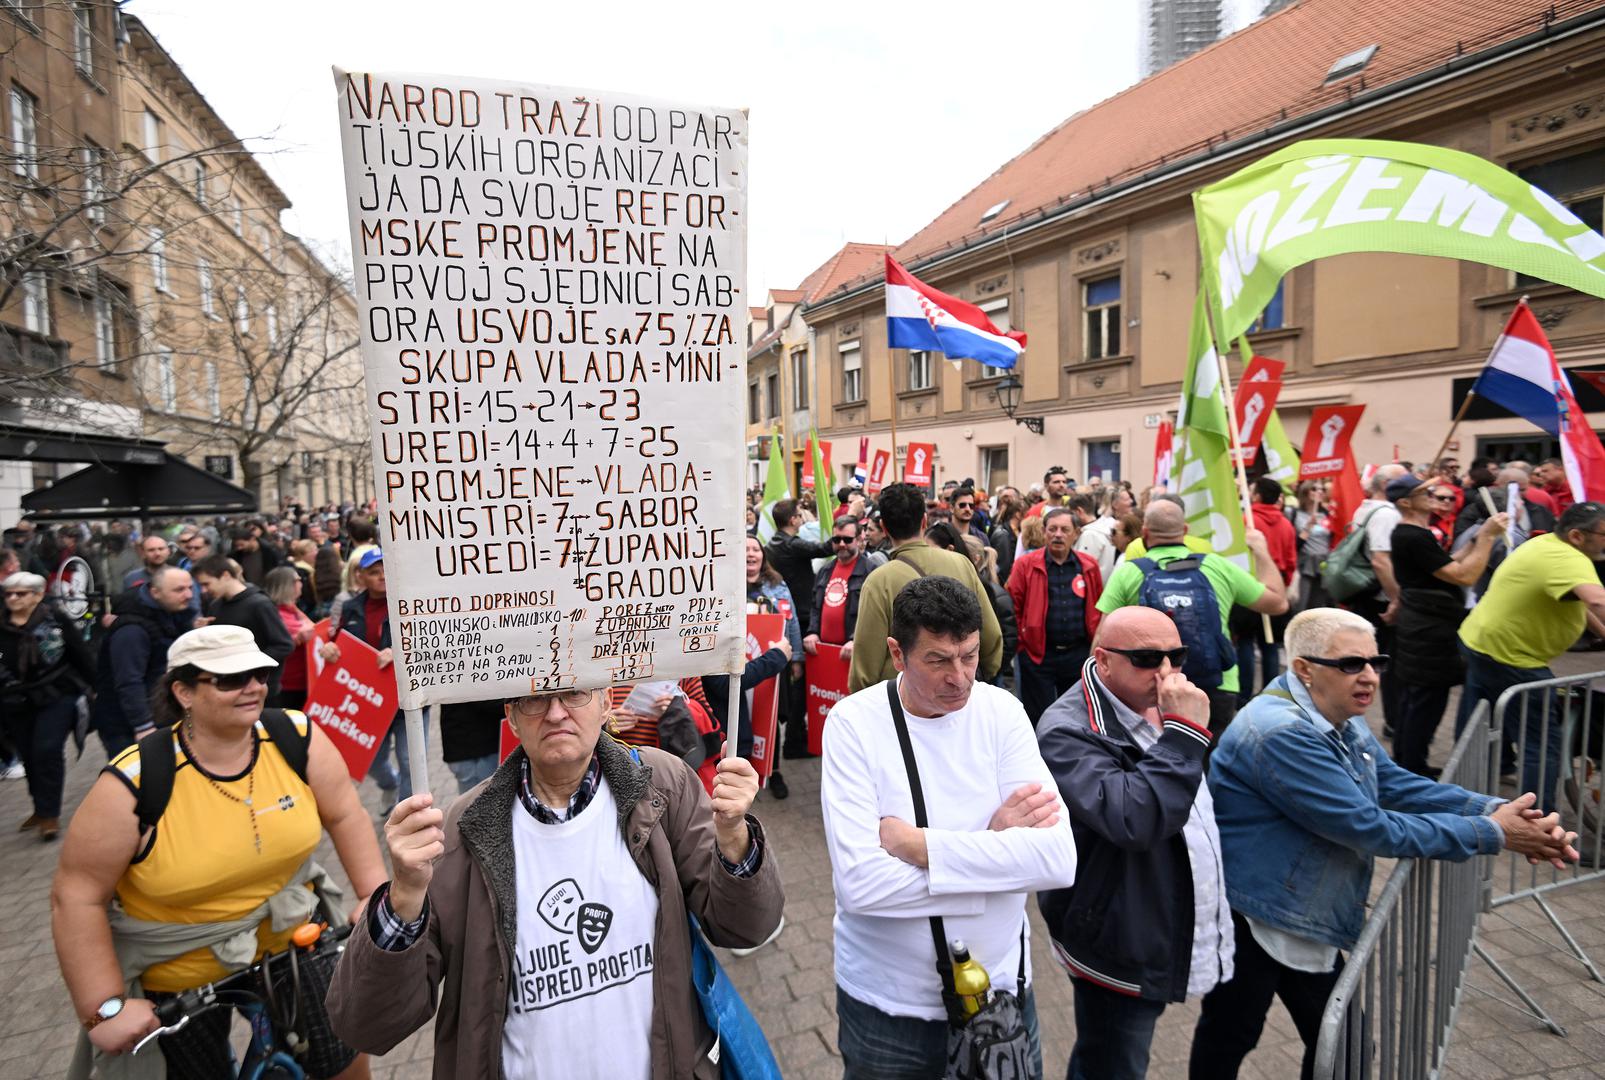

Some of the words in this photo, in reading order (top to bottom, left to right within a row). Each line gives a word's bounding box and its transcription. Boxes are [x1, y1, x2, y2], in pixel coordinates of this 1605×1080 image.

[346, 73, 481, 128] NAROD
[495, 92, 603, 138] TRAŽI
[614, 105, 657, 143] OD
[670, 110, 740, 150] PAR-
[352, 123, 503, 172] TIJSKIH
[359, 168, 407, 212] JA
[421, 175, 470, 215] DA
[485, 178, 603, 223] SVOJE
[616, 189, 738, 229] REFOR-
[360, 219, 463, 258] MSKE
[477, 223, 667, 267] PROMJENE
[679, 233, 717, 268] NA
[366, 261, 491, 301] PRVOJ
[504, 262, 661, 305] SJEDNICI
[370, 307, 446, 343] ORA
[456, 306, 600, 345] USVOJE
[400, 349, 522, 385] SKUPA
[386, 463, 574, 503] PROMJENE
[595, 496, 699, 531] SABOR
[584, 525, 726, 568] ŽUPANIJE
[585, 559, 715, 601] GRADOVI
[399, 596, 461, 615] BRUTO
[470, 590, 554, 611] DOPRINOSI
[603, 603, 653, 619] POREZ
[680, 612, 720, 623] POREZ
[400, 617, 490, 636] MIROVINSKO
[401, 637, 439, 651] BIRO
[445, 633, 481, 646] RADA
[679, 624, 719, 637] CARINE
[404, 644, 504, 664] ZDRAVSTVENO
[406, 661, 465, 676] POVREDA
[473, 659, 490, 669] NA
[497, 655, 532, 666] RADU
[335, 667, 384, 707] Dosta
[410, 674, 463, 691] BOLEST
[471, 672, 488, 682] PO
[496, 668, 536, 680] DANU
[338, 694, 359, 715] je
[308, 702, 376, 749] pljačke!
[547, 888, 566, 908] LJUDI
[585, 907, 608, 919] PROFIT
[516, 940, 572, 976] LJUDE
[587, 943, 653, 986] PROFITA
